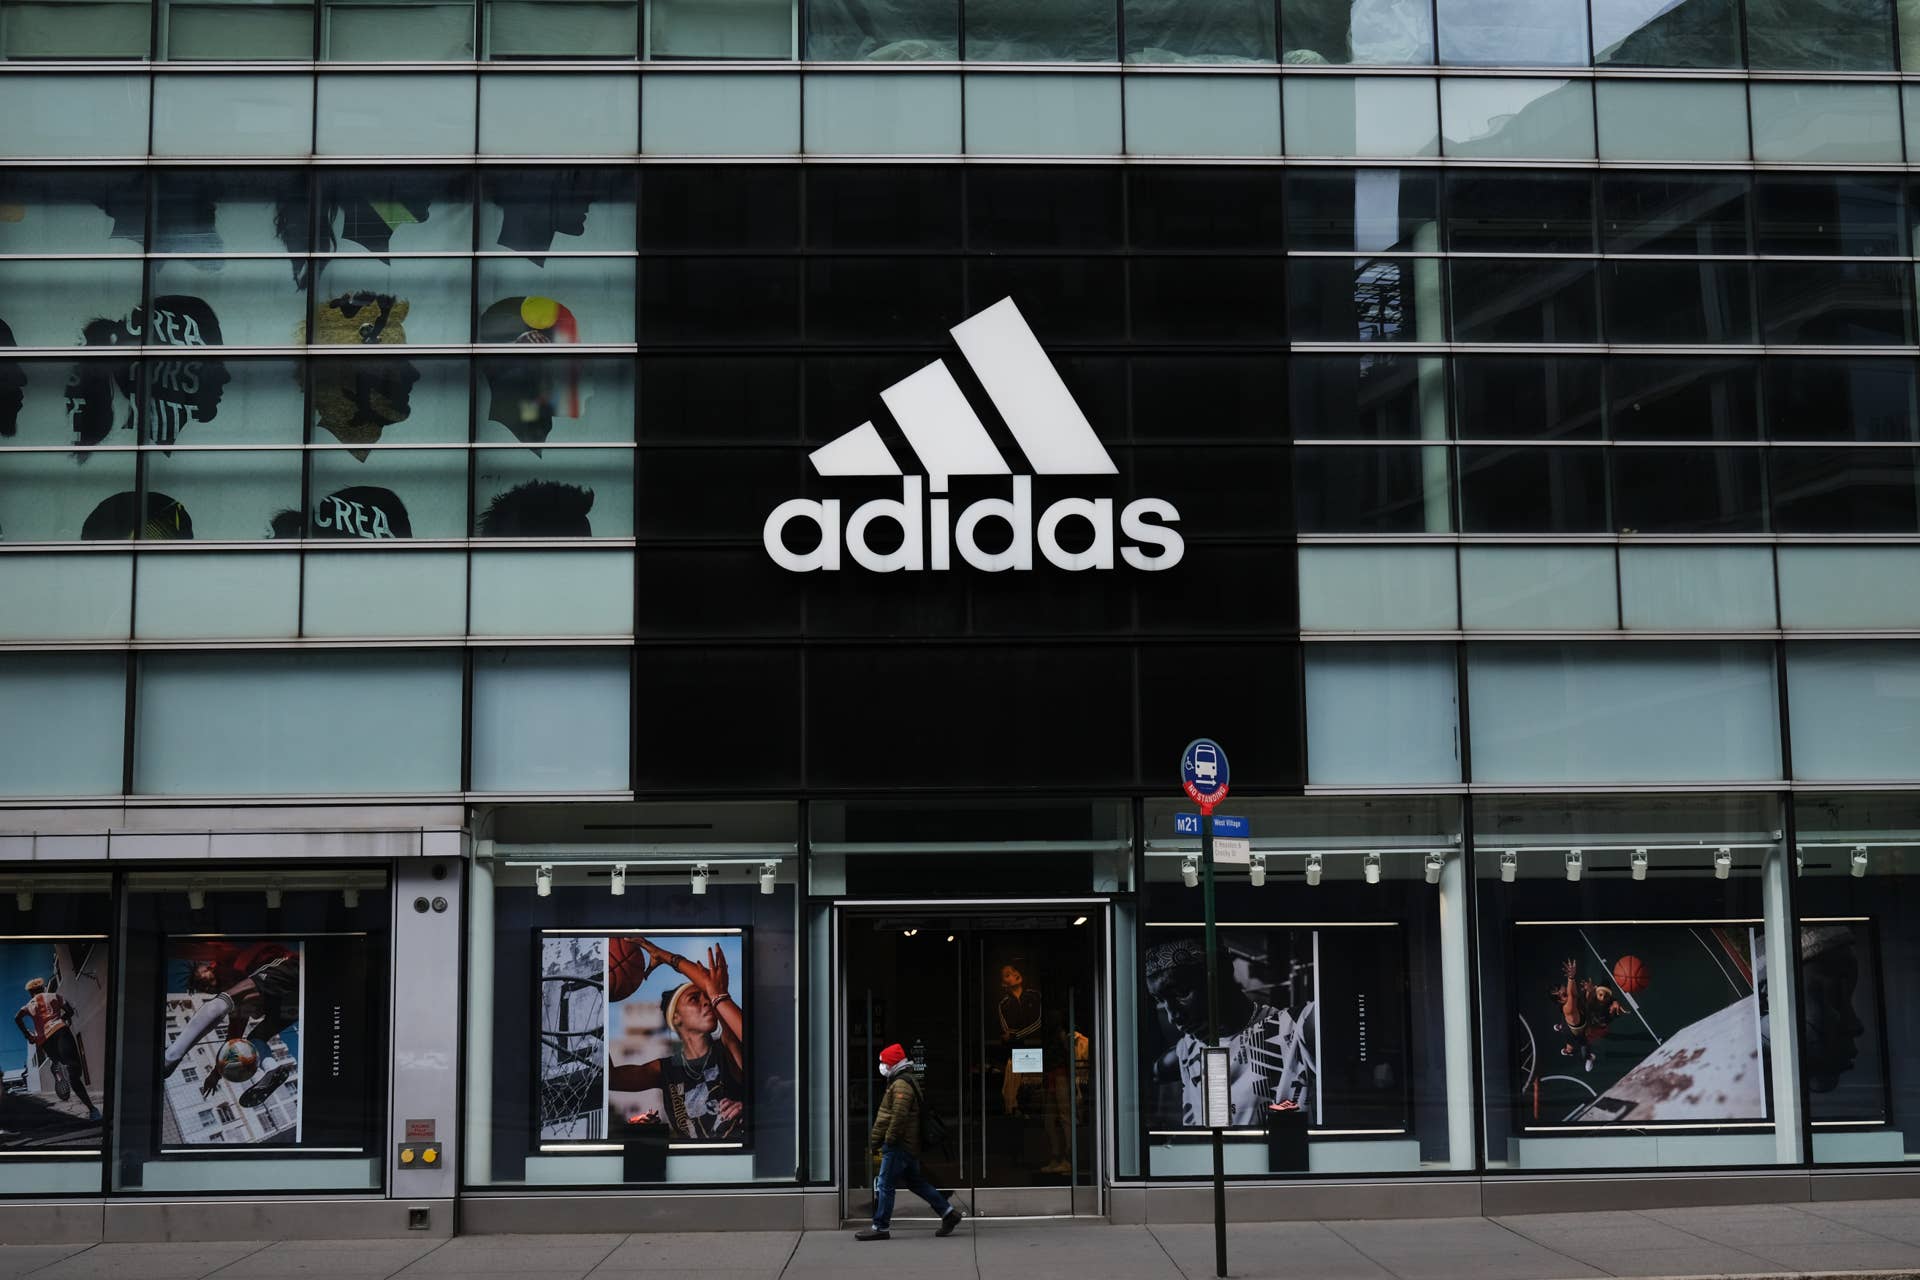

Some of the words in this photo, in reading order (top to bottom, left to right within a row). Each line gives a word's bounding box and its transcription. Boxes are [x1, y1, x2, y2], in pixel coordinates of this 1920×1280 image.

[763, 474, 1185, 573] adidas
[1188, 784, 1197, 796] NO
[1197, 785, 1226, 803] STANDING
[1178, 817, 1198, 832] M21
[1226, 820, 1241, 828] Village
